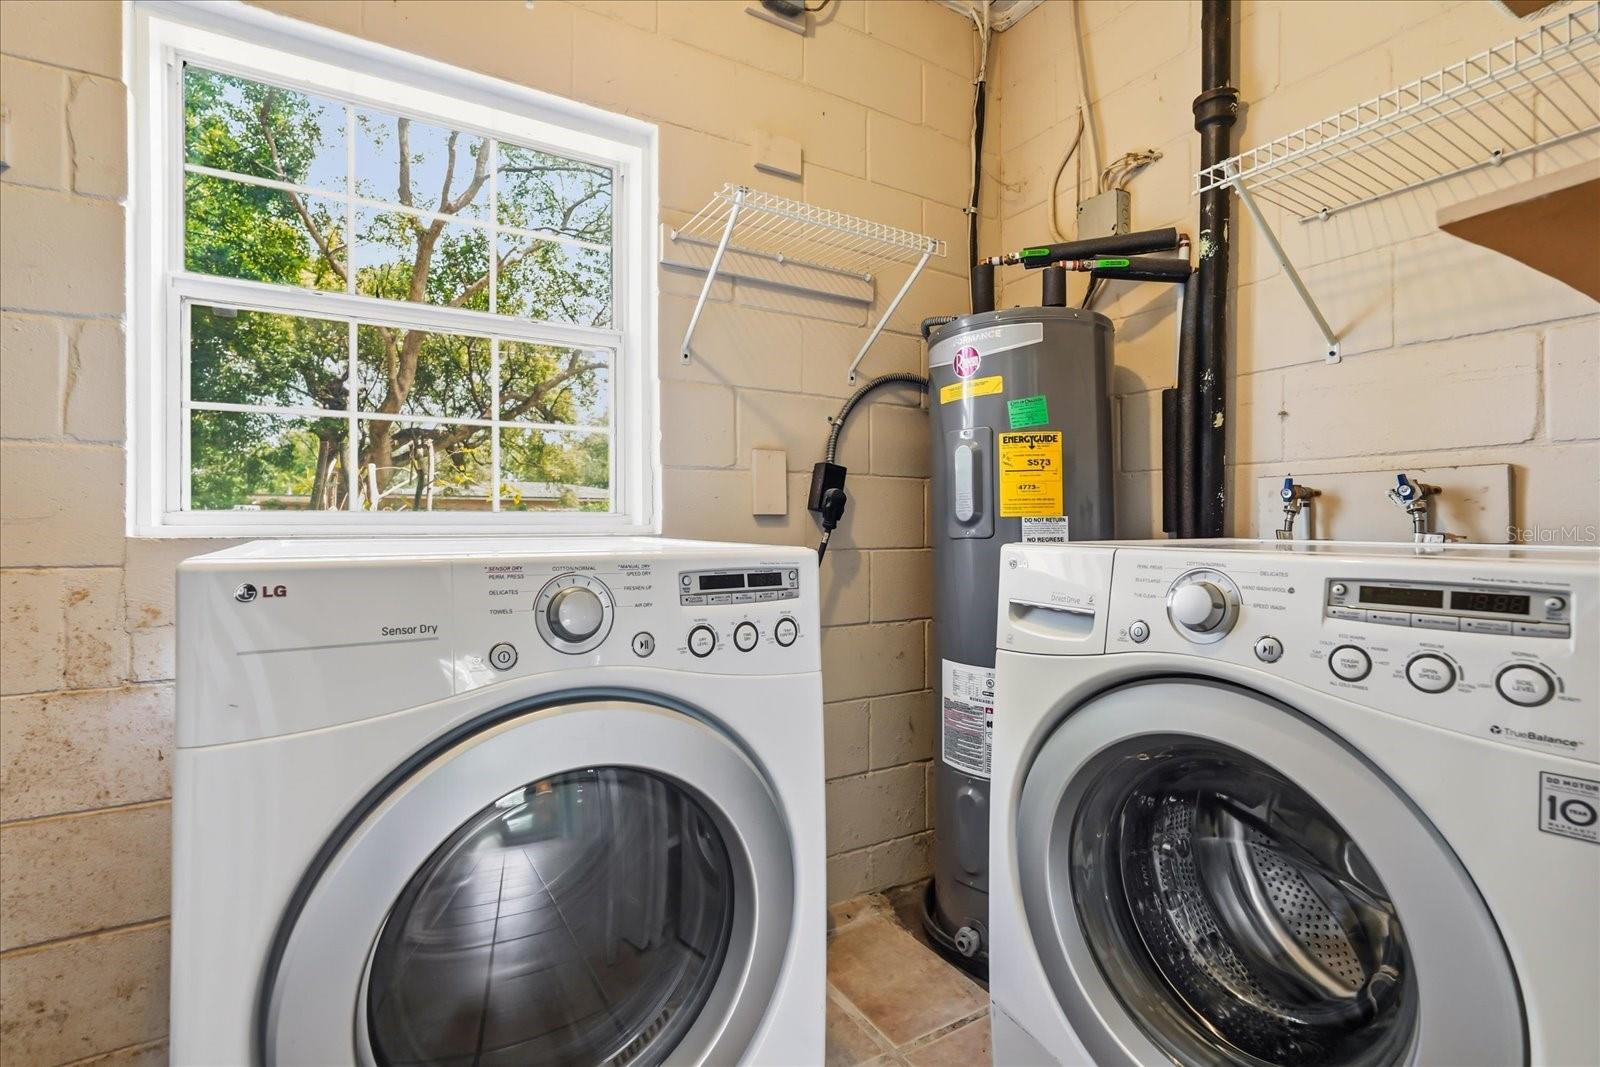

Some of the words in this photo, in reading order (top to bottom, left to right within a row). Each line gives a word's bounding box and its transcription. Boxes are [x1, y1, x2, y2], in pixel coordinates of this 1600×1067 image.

[953, 329, 1002, 347] ORMANCE
[1002, 434, 1058, 446] ENERGYGUIDE
[1259, 570, 1289, 578] DELICATES
[262, 584, 288, 599] LG
[381, 624, 417, 638] Sensor
[419, 624, 439, 637] Dry
[1504, 727, 1579, 748] TrueBalance
[1547, 794, 1599, 828] 10
